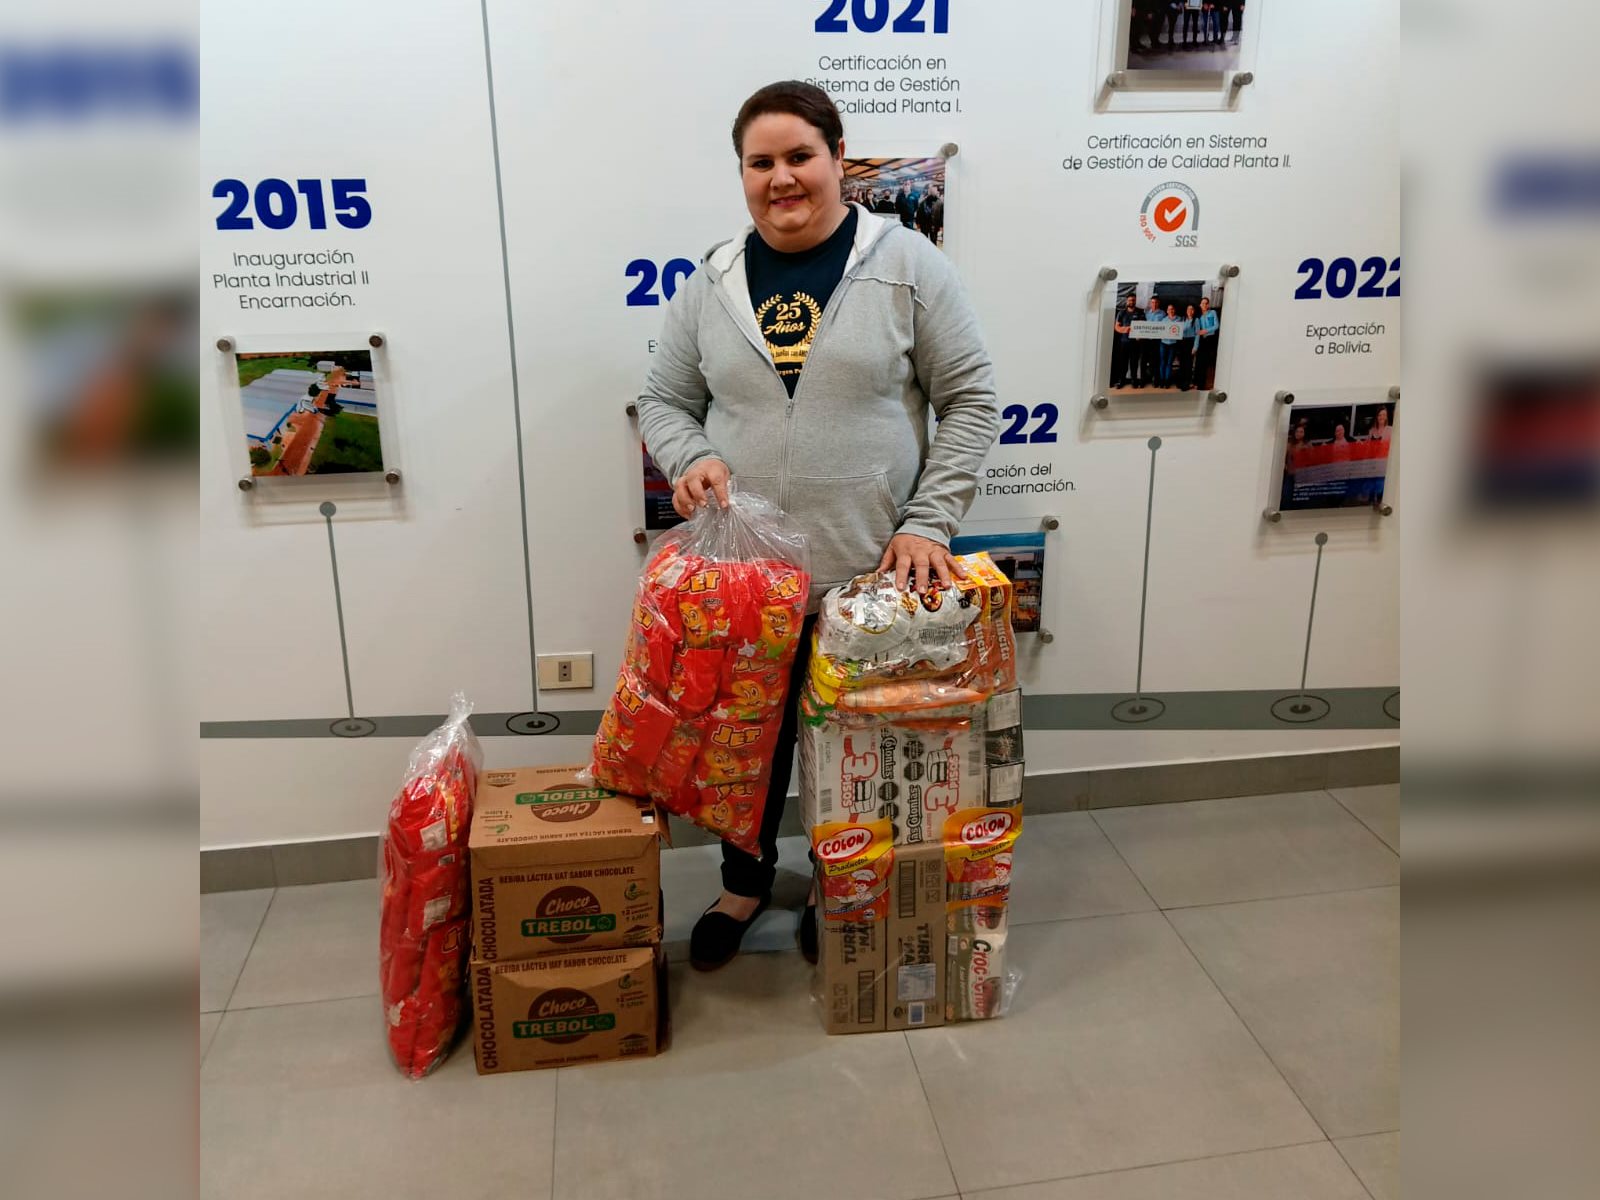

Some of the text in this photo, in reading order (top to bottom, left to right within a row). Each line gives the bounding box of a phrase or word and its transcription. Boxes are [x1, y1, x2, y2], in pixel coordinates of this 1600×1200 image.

[815, 0, 950, 33] 2021
[818, 54, 947, 71] Certificación en
[873, 77, 895, 92] de
[899, 76, 960, 92] Gestión
[902, 99, 951, 113] Planta
[1087, 134, 1268, 149] Certificación en Sistema
[1062, 156, 1083, 170] de
[1086, 154, 1144, 170] Gestión
[1147, 154, 1168, 169] de
[1171, 154, 1230, 169] Calidad
[1233, 154, 1279, 169] Planta
[212, 177, 372, 230] 2015
[1174, 235, 1198, 247] SGS
[233, 249, 355, 270] Inauguración
[213, 270, 370, 289] Planta Industrial II
[625, 258, 698, 306] 20
[239, 292, 356, 310] Encarnación.
[775, 301, 802, 321] 25
[763, 320, 806, 335] Años
[1305, 323, 1385, 341] Exportación
[1314, 340, 1373, 355] a Bolivia.
[986, 462, 1052, 478] ación del
[986, 479, 1076, 496] Encarnación.
[711, 725, 762, 747] JET
[841, 751, 879, 808] 3 PISOS
[906, 785, 922, 828] Colonias
[924, 784, 959, 812] 3
[542, 803, 591, 818] Choco
[965, 815, 1007, 841] COLON
[821, 831, 866, 857] COLON
[828, 856, 869, 874] Productos
[499, 873, 525, 884] BEBIDA
[594, 866, 635, 878] CHOCOLATE
[545, 895, 591, 916] Choco
[478, 877, 497, 961] CHOCOLATADA
[526, 918, 596, 934] TREBOL
[587, 954, 628, 966] CHOCOLATE
[538, 996, 588, 1017] Choco
[477, 966, 498, 1070] CHOCOLATADA
[517, 1018, 594, 1036] TREBOL
